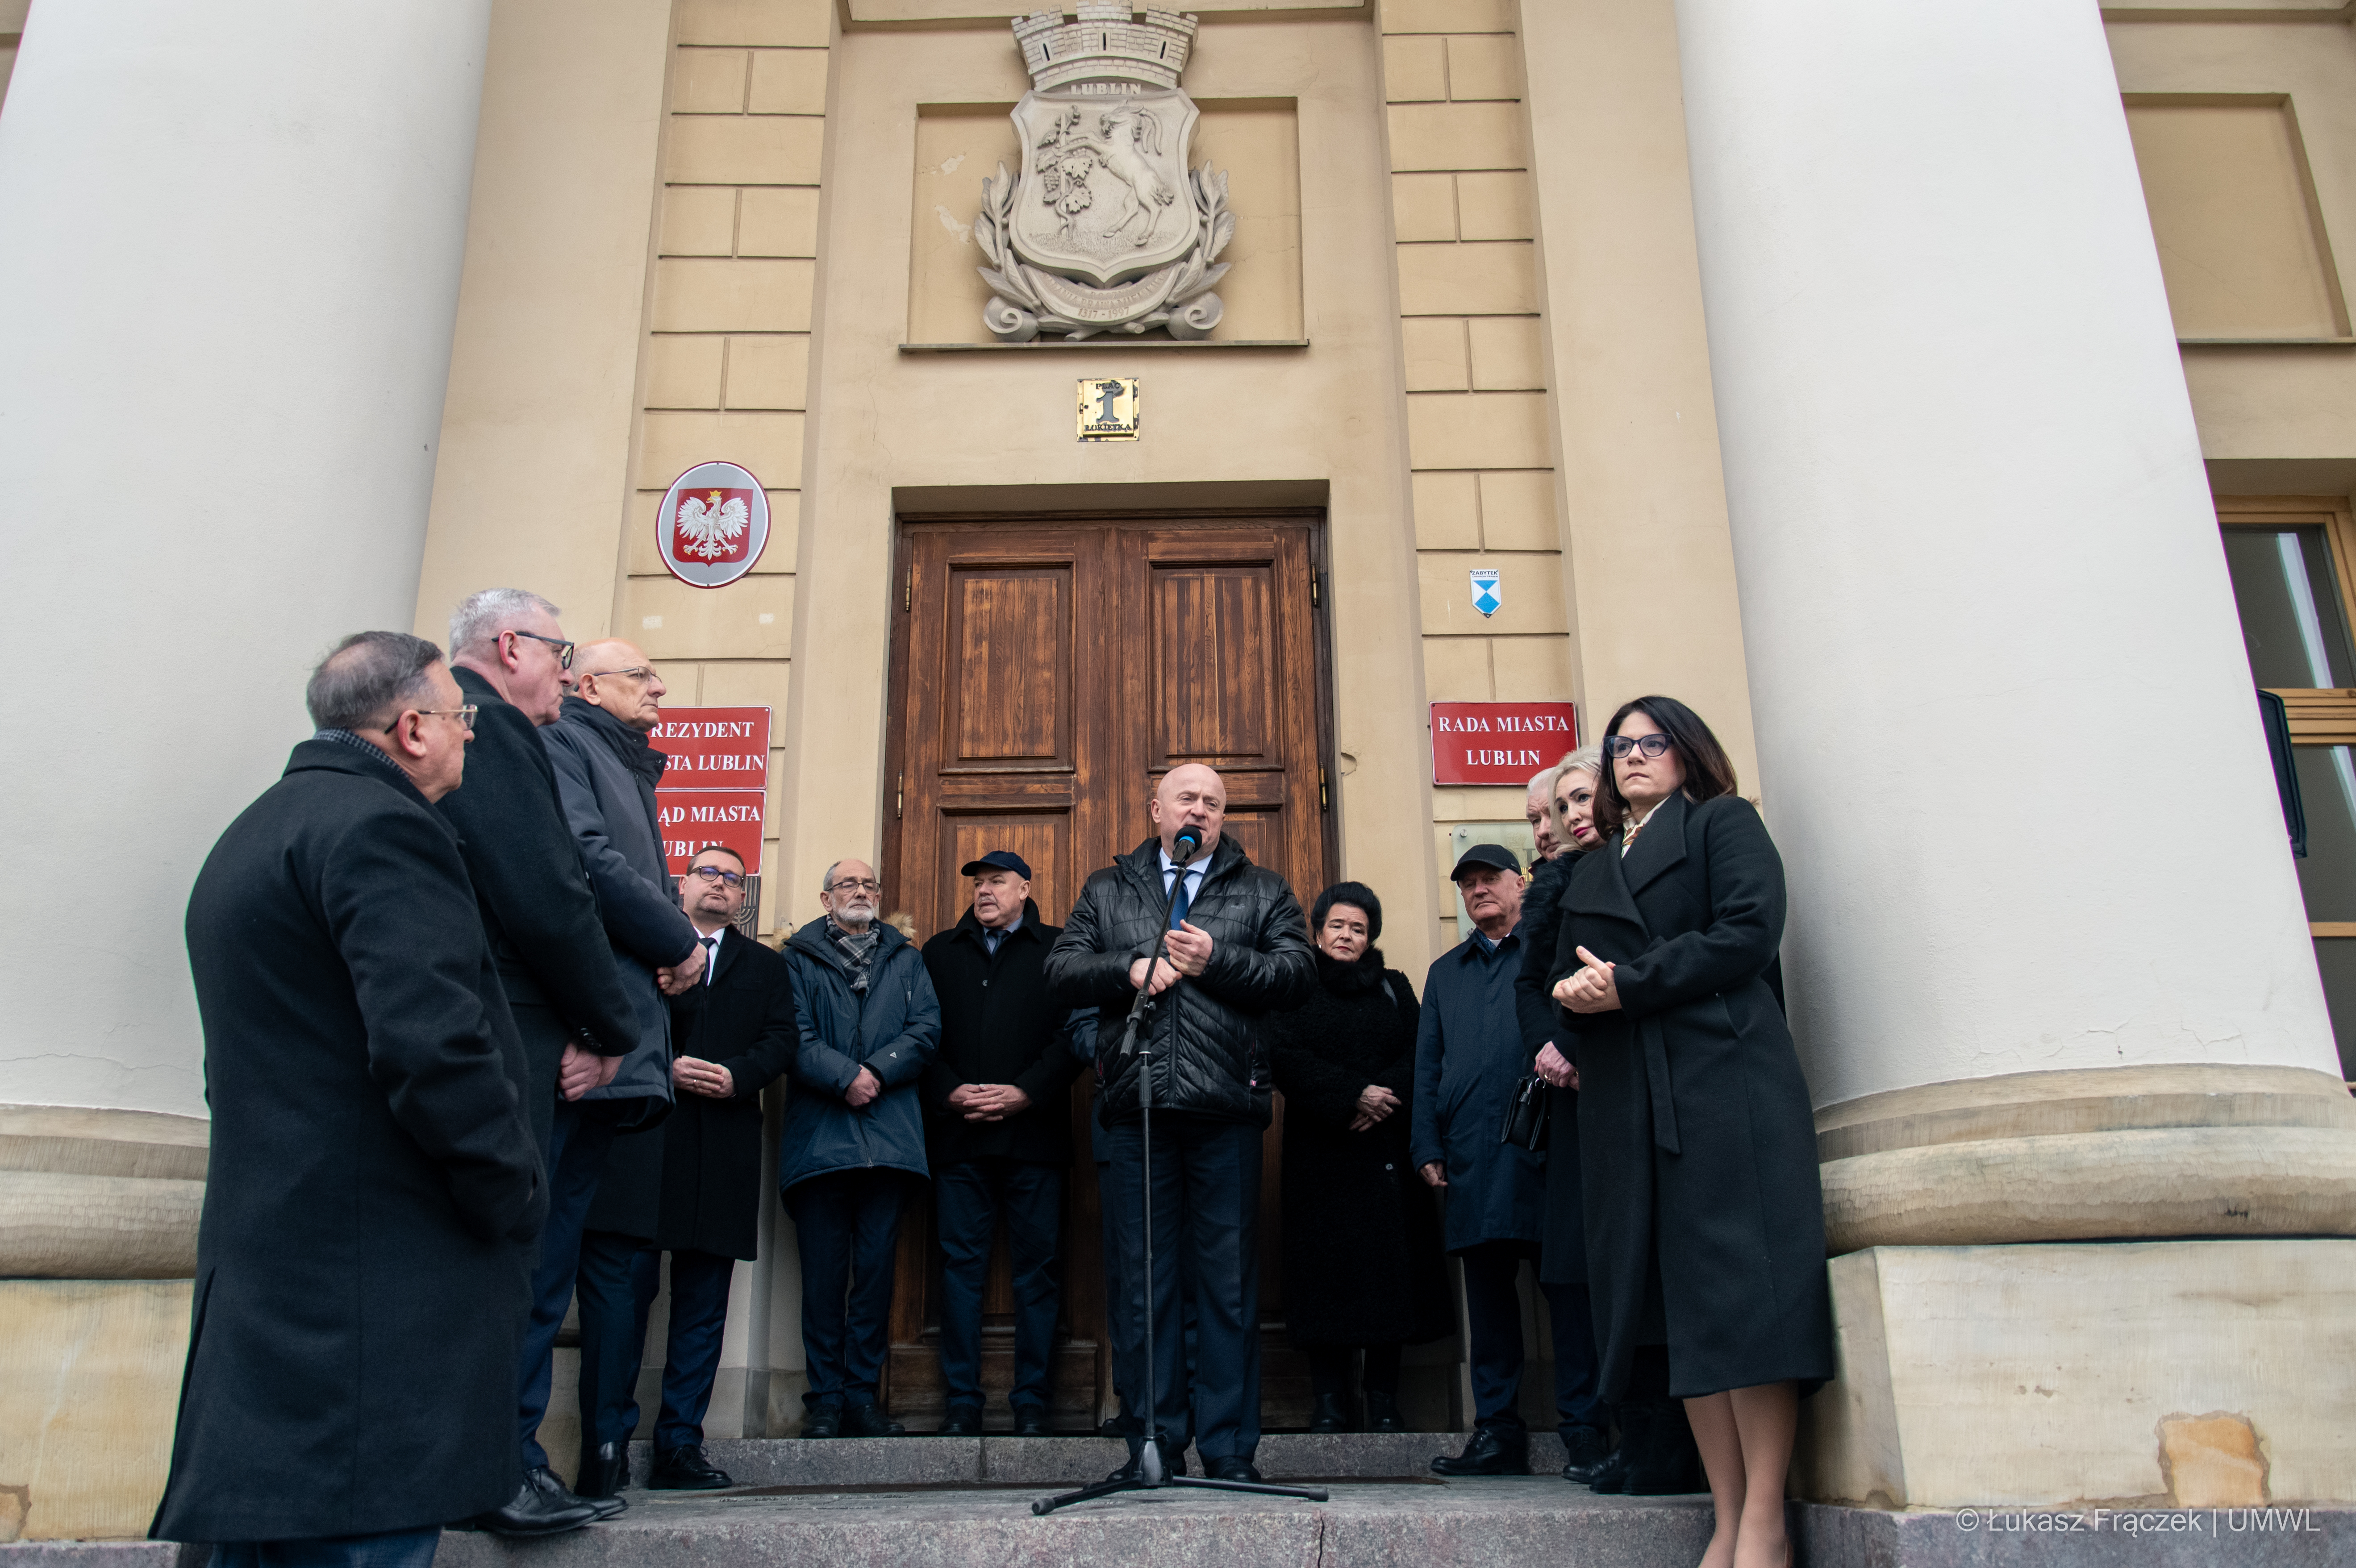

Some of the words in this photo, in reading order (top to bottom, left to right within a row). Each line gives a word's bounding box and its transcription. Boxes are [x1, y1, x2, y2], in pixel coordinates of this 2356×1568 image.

[1071, 83, 1141, 95] LUBLIN
[1077, 308, 1098, 319] 1317
[1108, 307, 1129, 319] 1997
[1096, 391, 1119, 423] 1
[651, 721, 754, 738] REZYDENT
[1438, 717, 1490, 732] RADA
[1497, 716, 1570, 732] MIASTA
[664, 755, 692, 770] STA
[698, 754, 765, 770] LUBLIN
[1466, 750, 1540, 765] LUBLIN
[690, 805, 761, 822] MIASTA
[663, 840, 723, 856] UBL
